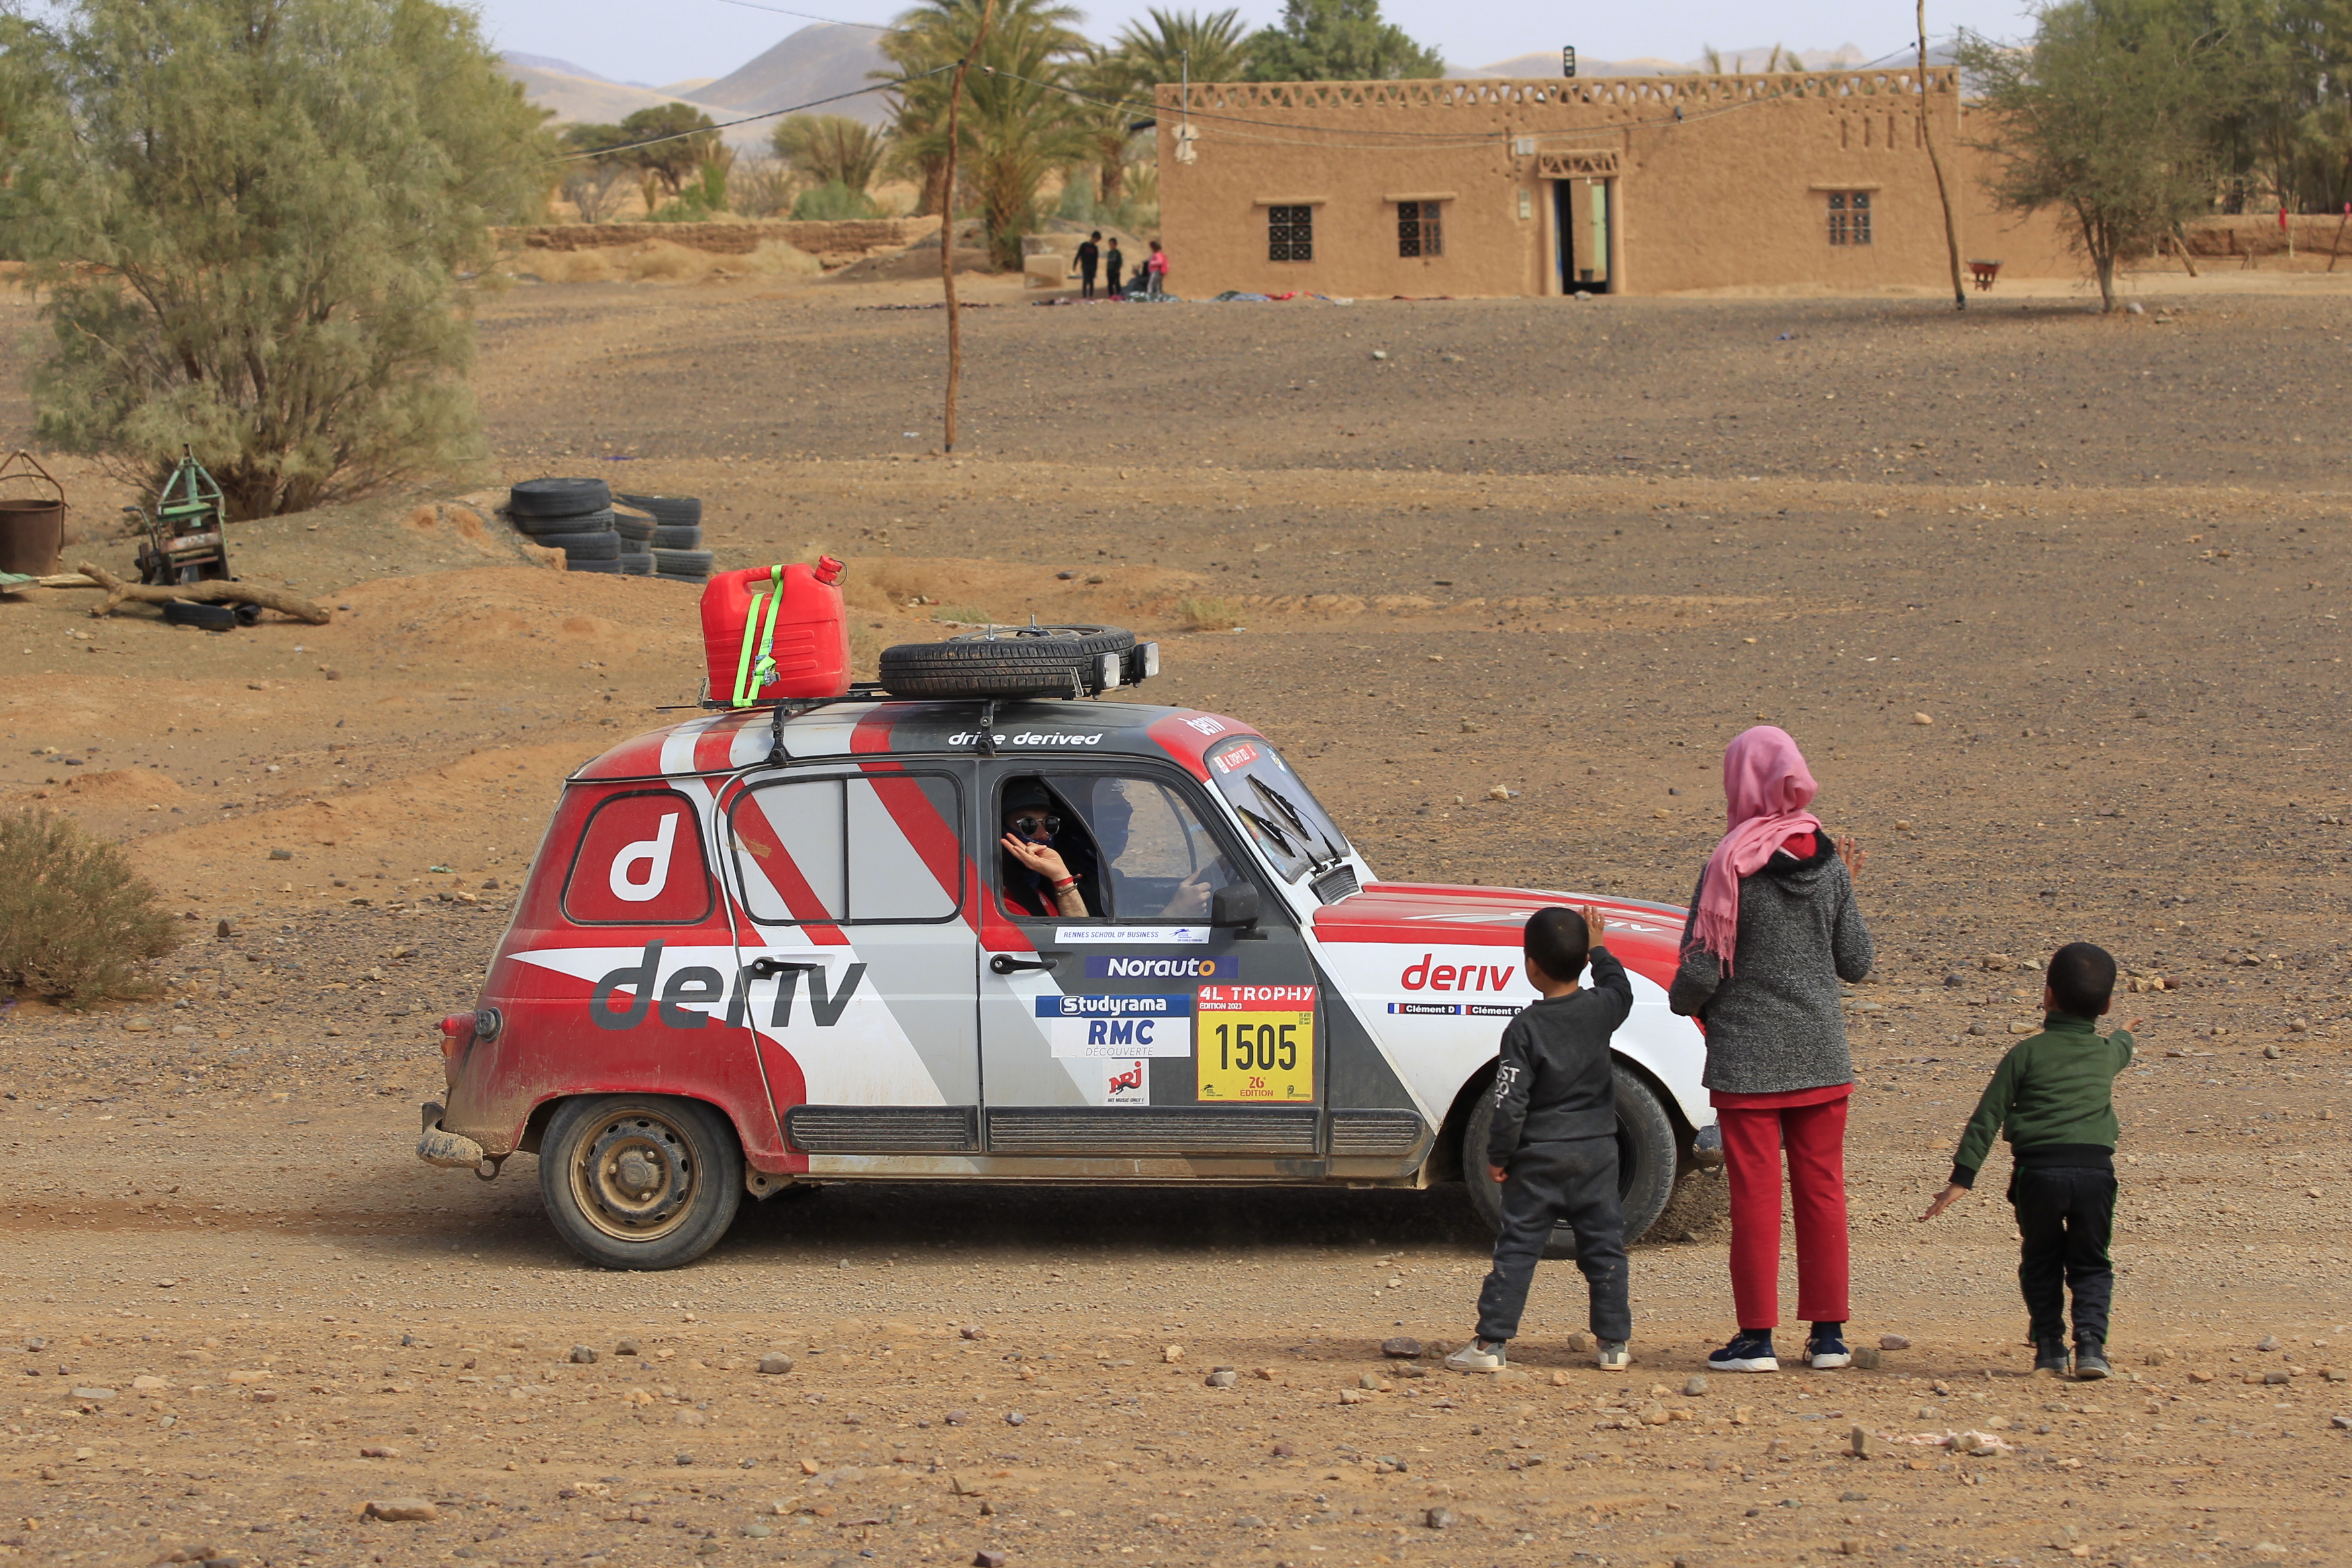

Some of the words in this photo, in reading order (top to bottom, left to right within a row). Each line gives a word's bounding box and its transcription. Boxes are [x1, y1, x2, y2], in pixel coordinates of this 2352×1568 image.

[948, 732, 1006, 746] drie
[1012, 732, 1103, 745] derived
[609, 812, 679, 901] d
[1107, 957, 1216, 977] Norauto
[1400, 953, 1515, 991] deriv
[589, 938, 867, 1030] deriv
[1199, 986, 1224, 1001] 4L
[1230, 986, 1314, 1001] TROPHY
[1062, 995, 1167, 1016] Studyrama
[1199, 1001, 1226, 1010] ÉDITION
[1406, 1004, 1446, 1014] Clément
[1447, 1005, 1455, 1014] D
[1472, 1006, 1512, 1015] Clément
[1087, 1019, 1155, 1046] RMC
[1085, 1046, 1154, 1056] DÉCOUVERTE
[1215, 1024, 1297, 1071] 1505
[1496, 1065, 1520, 1083] UST
[1240, 1087, 1274, 1097] ÉDITION
